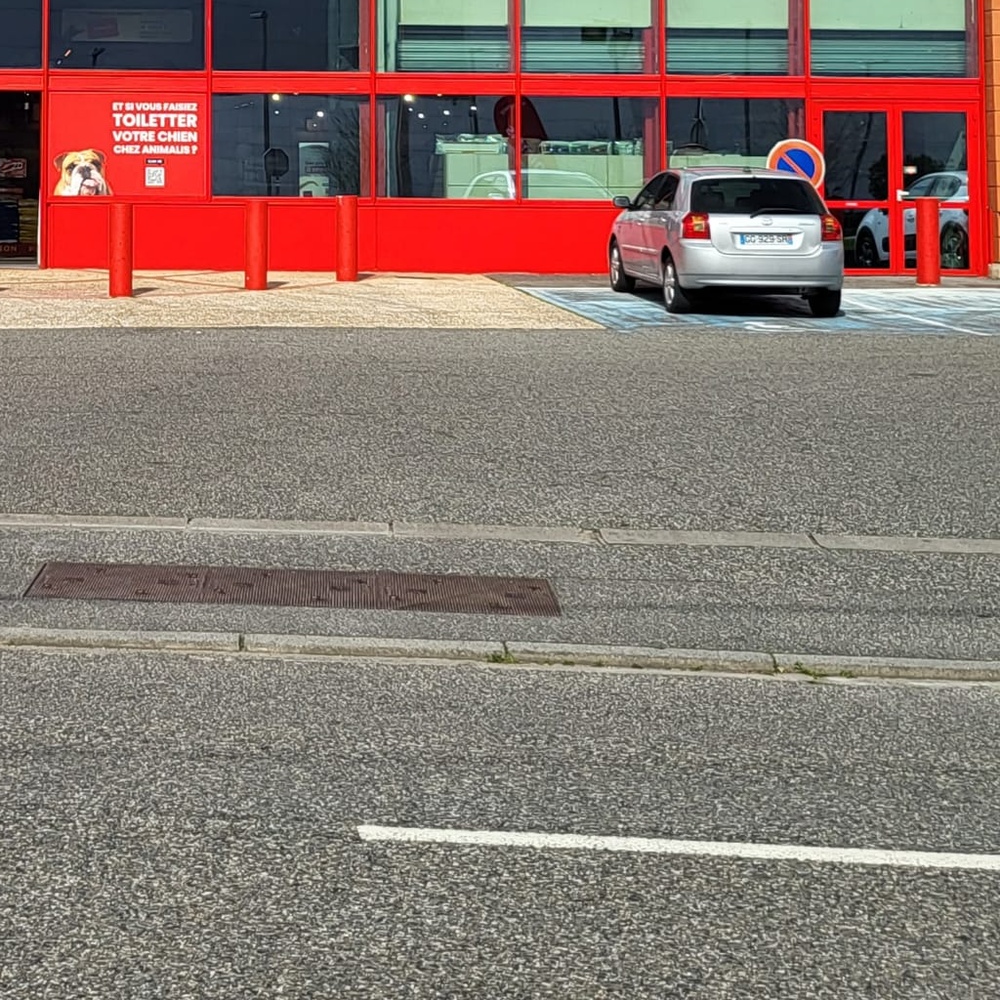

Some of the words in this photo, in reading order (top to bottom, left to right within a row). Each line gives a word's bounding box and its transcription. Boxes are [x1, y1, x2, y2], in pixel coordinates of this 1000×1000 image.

[112, 102, 124, 111] ET
[125, 102, 135, 111] SI
[135, 102, 162, 111] VOUS
[112, 113, 197, 128] TOILETTER
[112, 130, 155, 142] VOTRE
[157, 131, 197, 142] CHIEN
[113, 145, 140, 154] CHEZ
[141, 145, 190, 154] ANIMALIS
